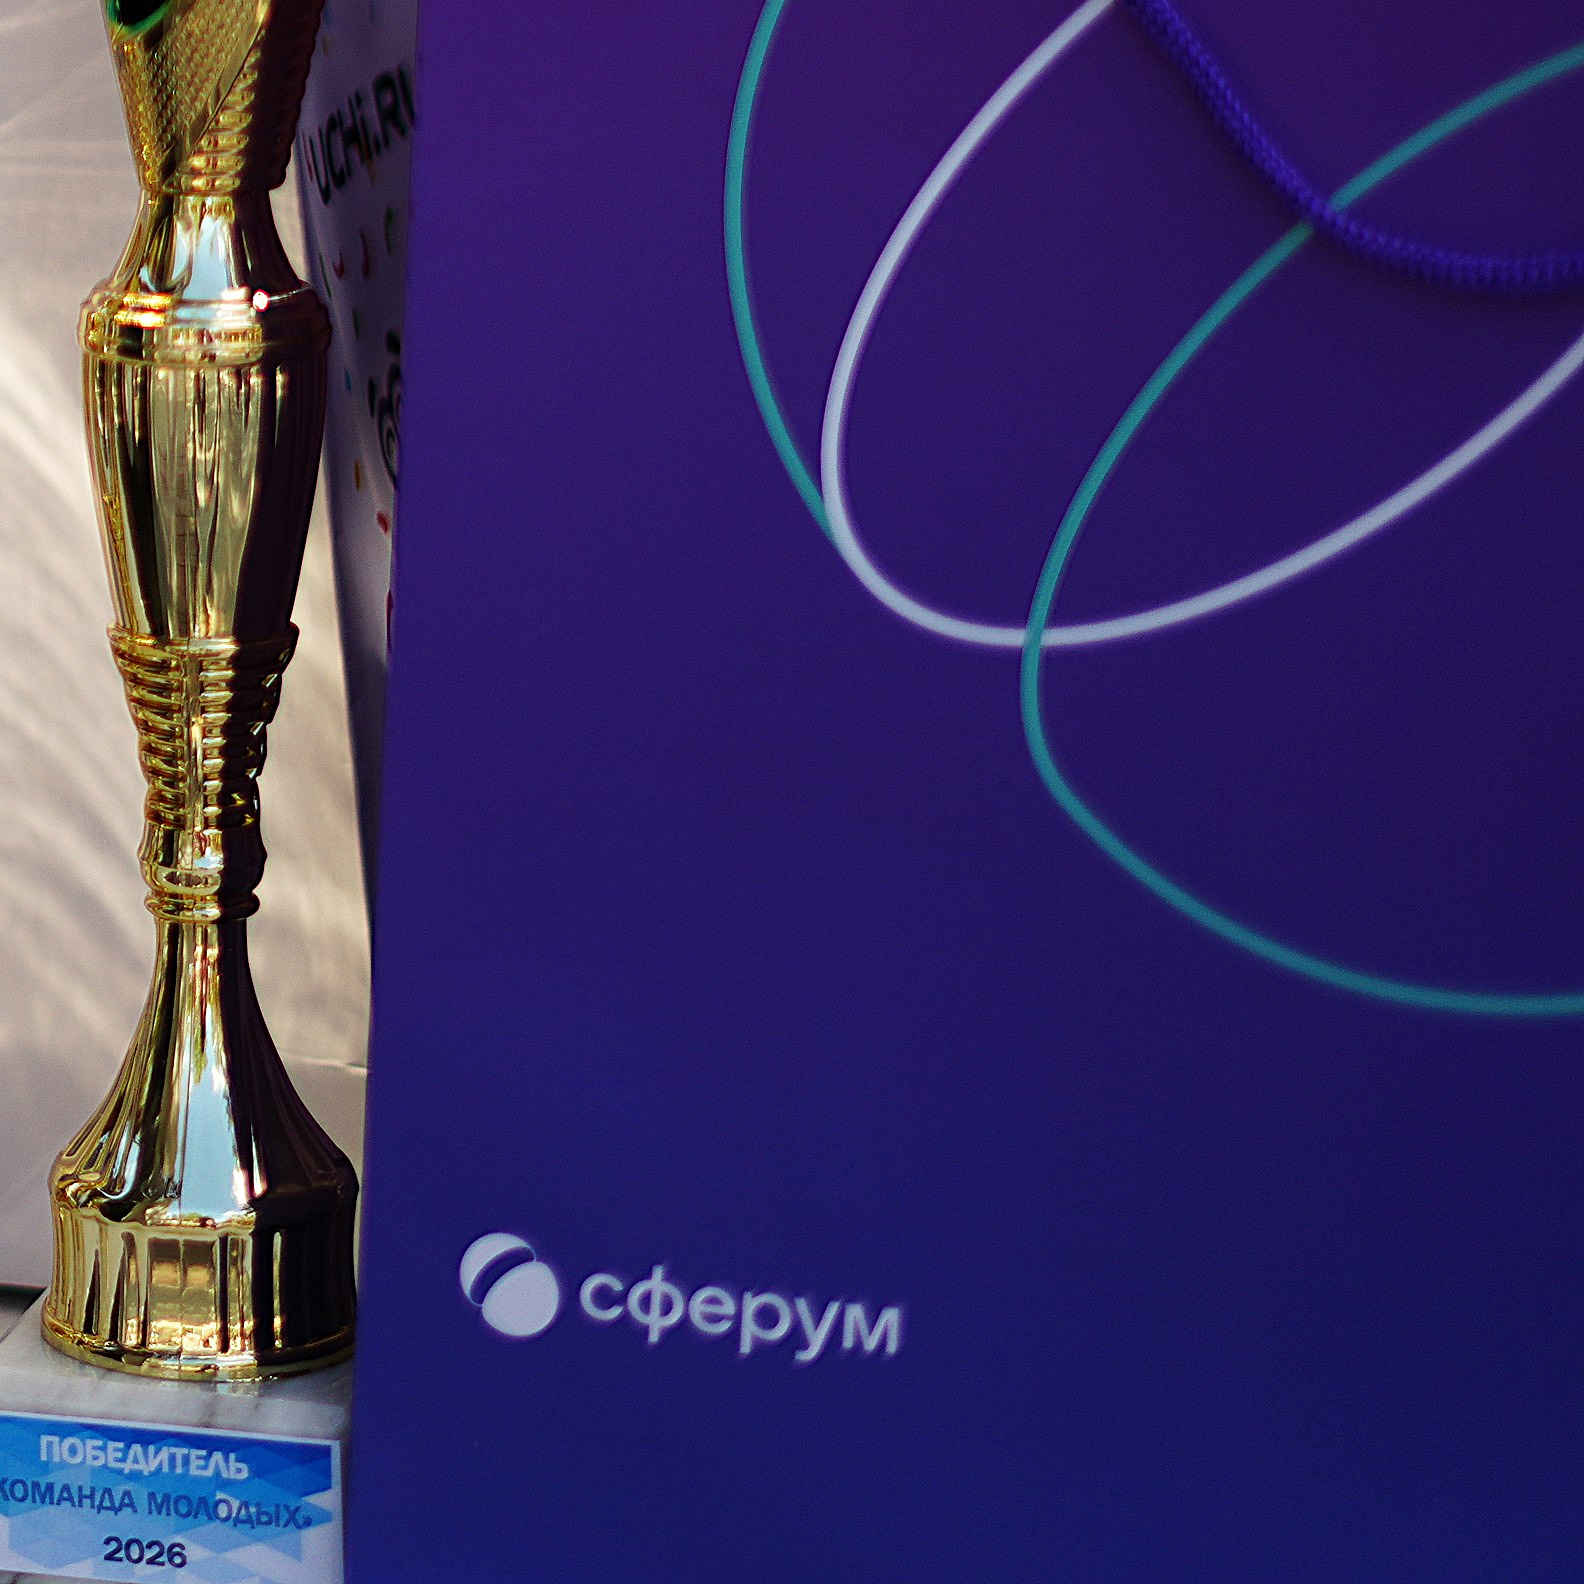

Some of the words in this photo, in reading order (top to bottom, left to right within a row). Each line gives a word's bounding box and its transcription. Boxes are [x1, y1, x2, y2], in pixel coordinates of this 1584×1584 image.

[579, 1264, 902, 1363] сферум
[40, 1435, 249, 1480] ПОБЕДИТЕЛЬ
[147, 1491, 313, 1530] МОЛОДЫХ»
[103, 1536, 187, 1568] 2026
